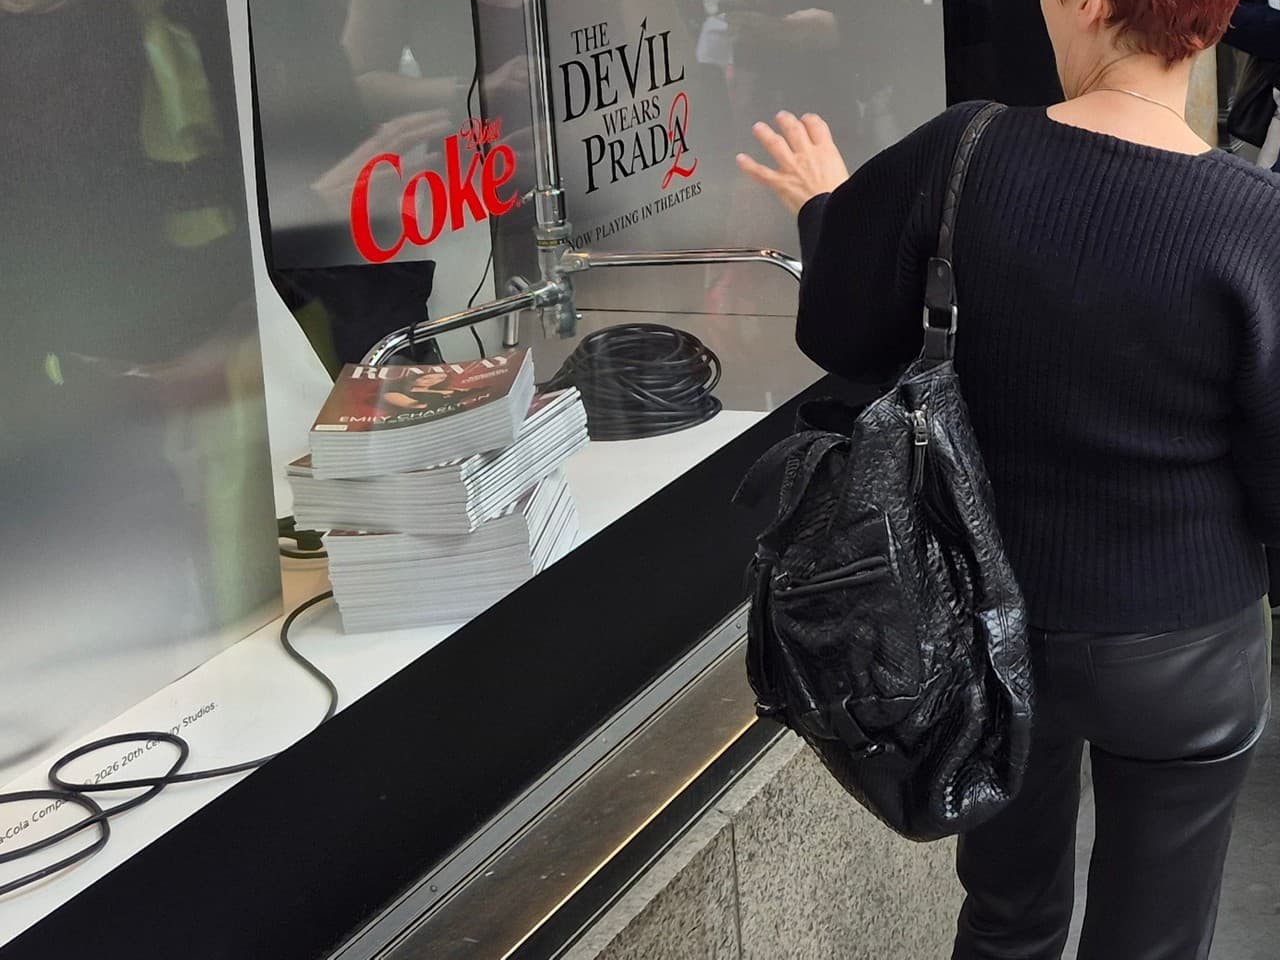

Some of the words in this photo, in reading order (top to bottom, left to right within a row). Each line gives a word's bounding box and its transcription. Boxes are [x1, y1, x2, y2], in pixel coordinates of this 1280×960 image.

[559, 16, 685, 122] DEVIL
[571, 22, 610, 55] THE
[581, 115, 690, 195] PRADA
[661, 92, 698, 190] 2
[602, 95, 661, 137] WEARS
[351, 134, 519, 264] Coke
[568, 232, 594, 252] NOW
[595, 210, 640, 244] PLAYING
[641, 204, 653, 220] IN
[654, 182, 702, 215] THEATERS
[32, 799, 65, 823] Comp
[95, 761, 120, 785] 2026
[121, 747, 144, 767] 20th
[145, 723, 181, 751] Cery
